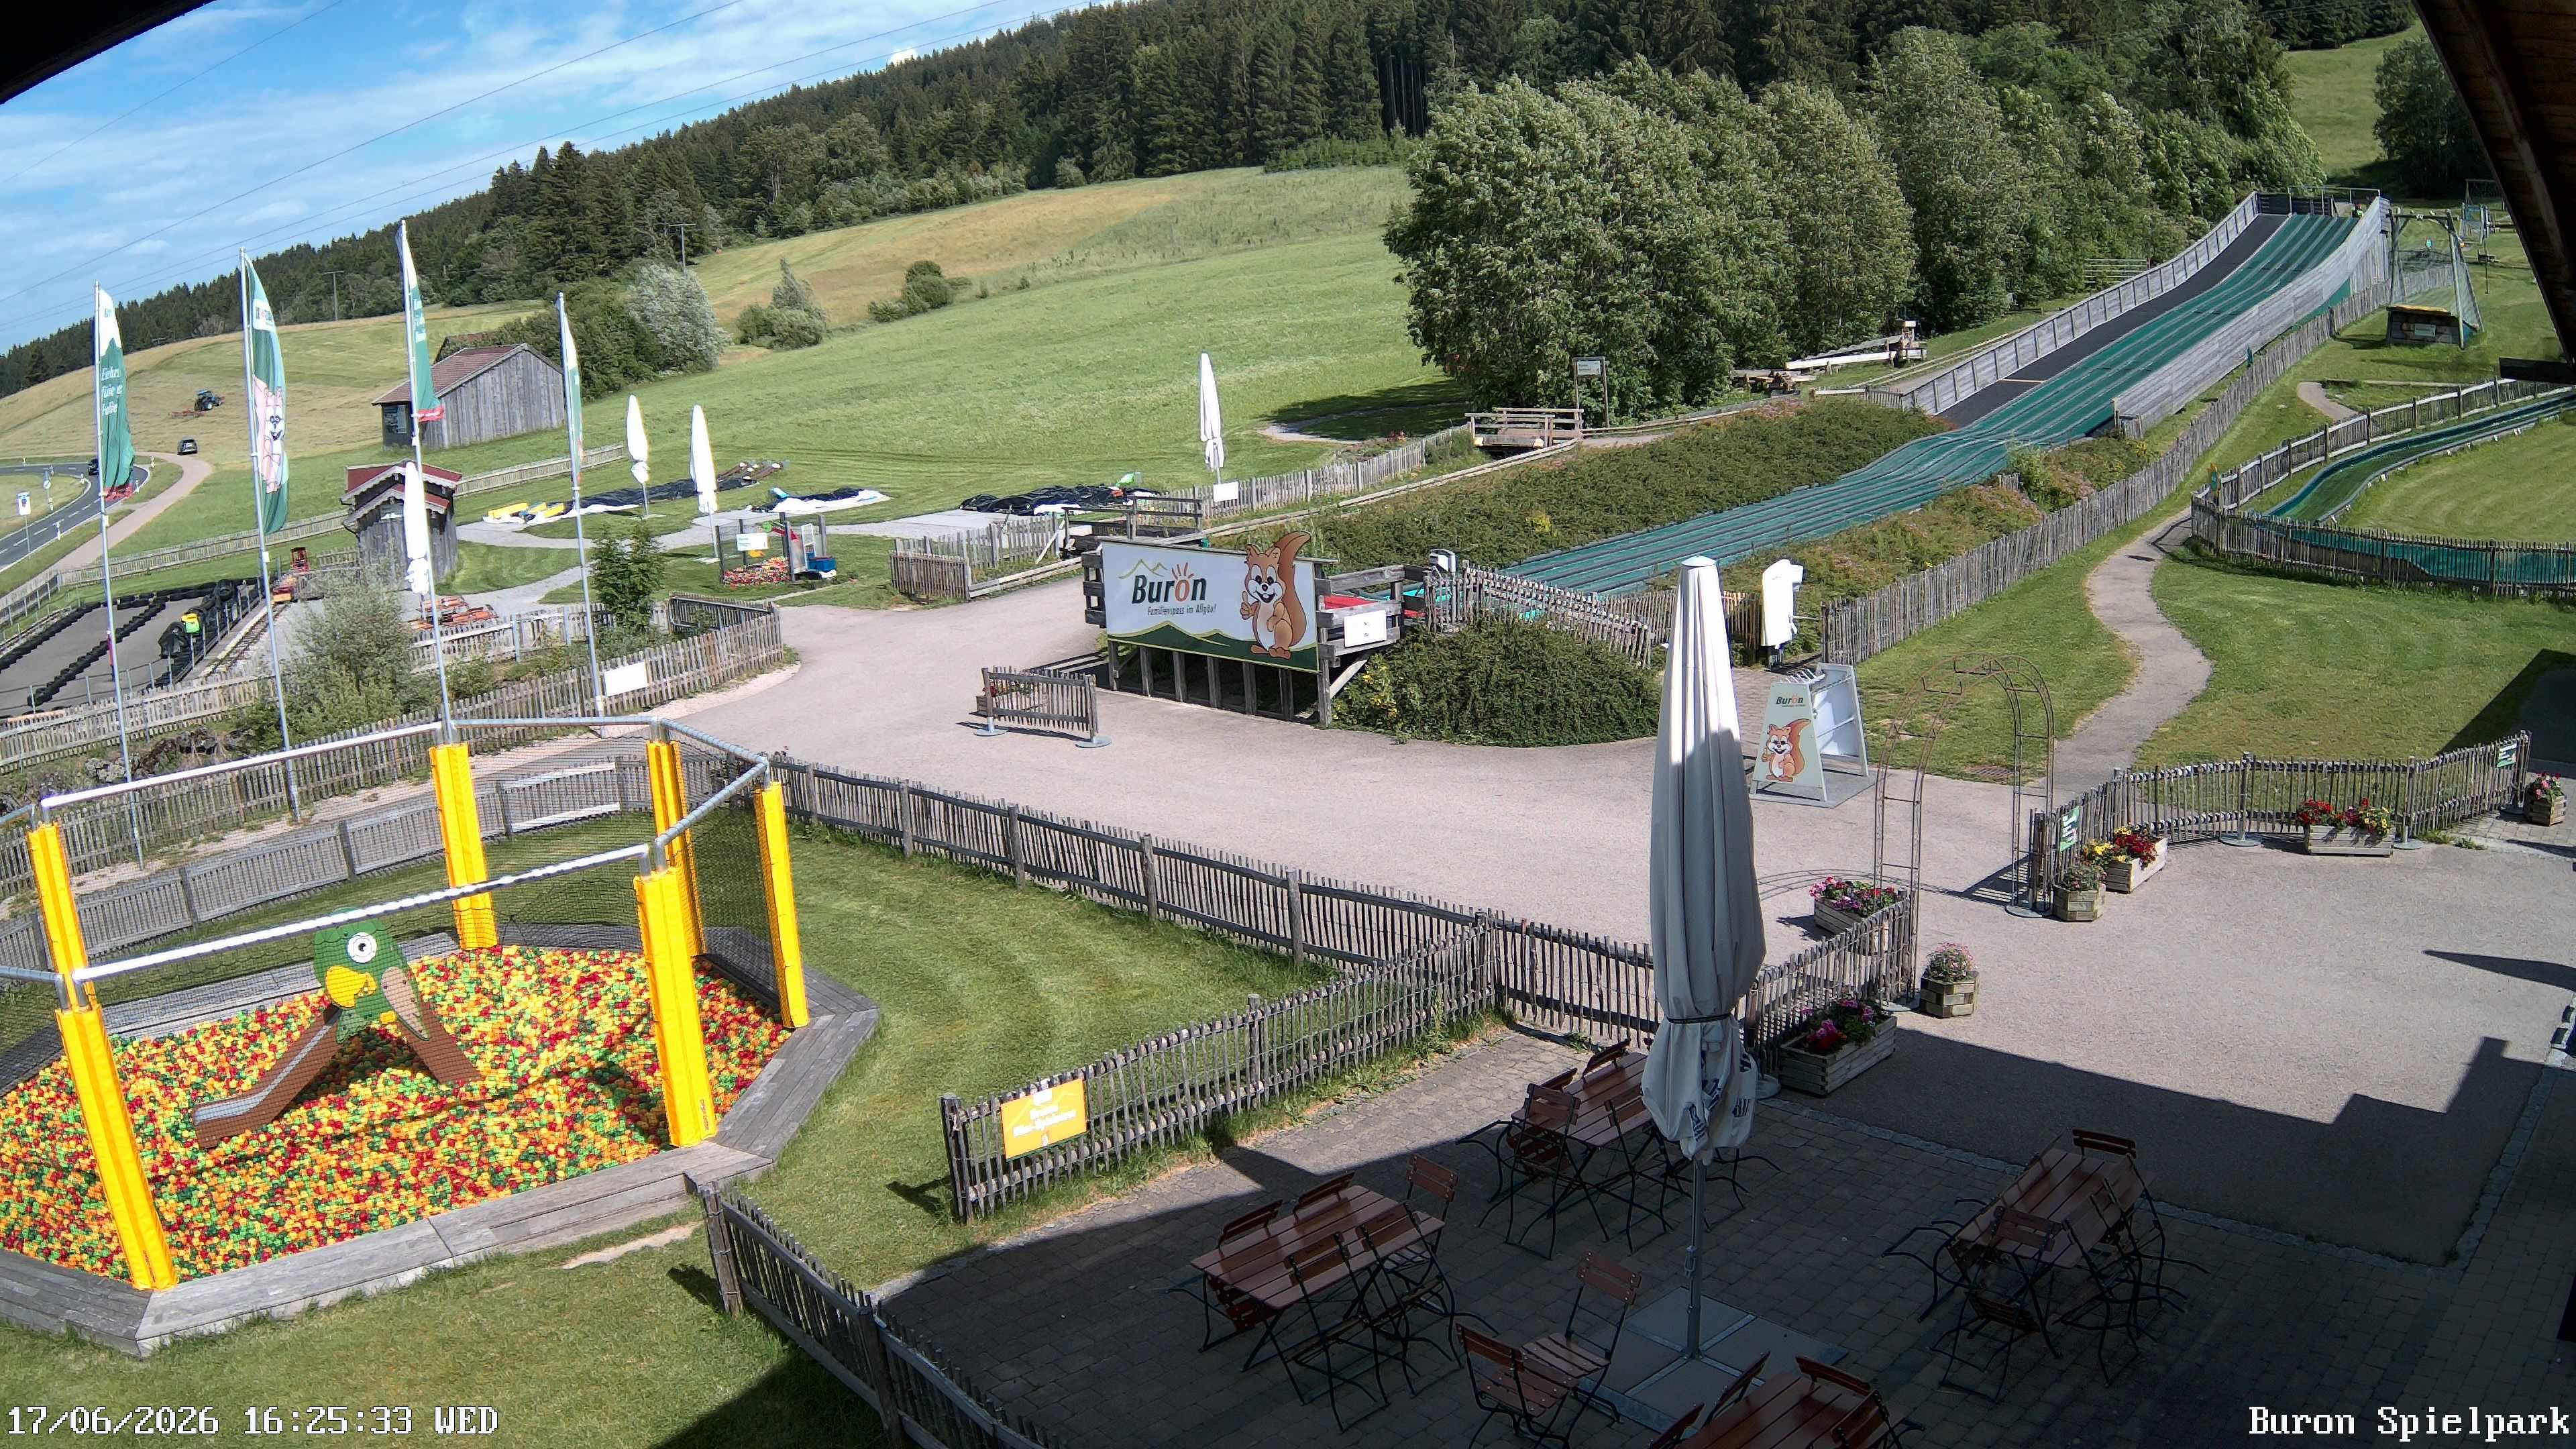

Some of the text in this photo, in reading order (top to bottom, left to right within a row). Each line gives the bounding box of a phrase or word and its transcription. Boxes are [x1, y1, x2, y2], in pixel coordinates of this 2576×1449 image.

[1131, 573, 1207, 604] Buron
[1186, 605, 1194, 614] im
[1776, 696, 1804, 705] Buron
